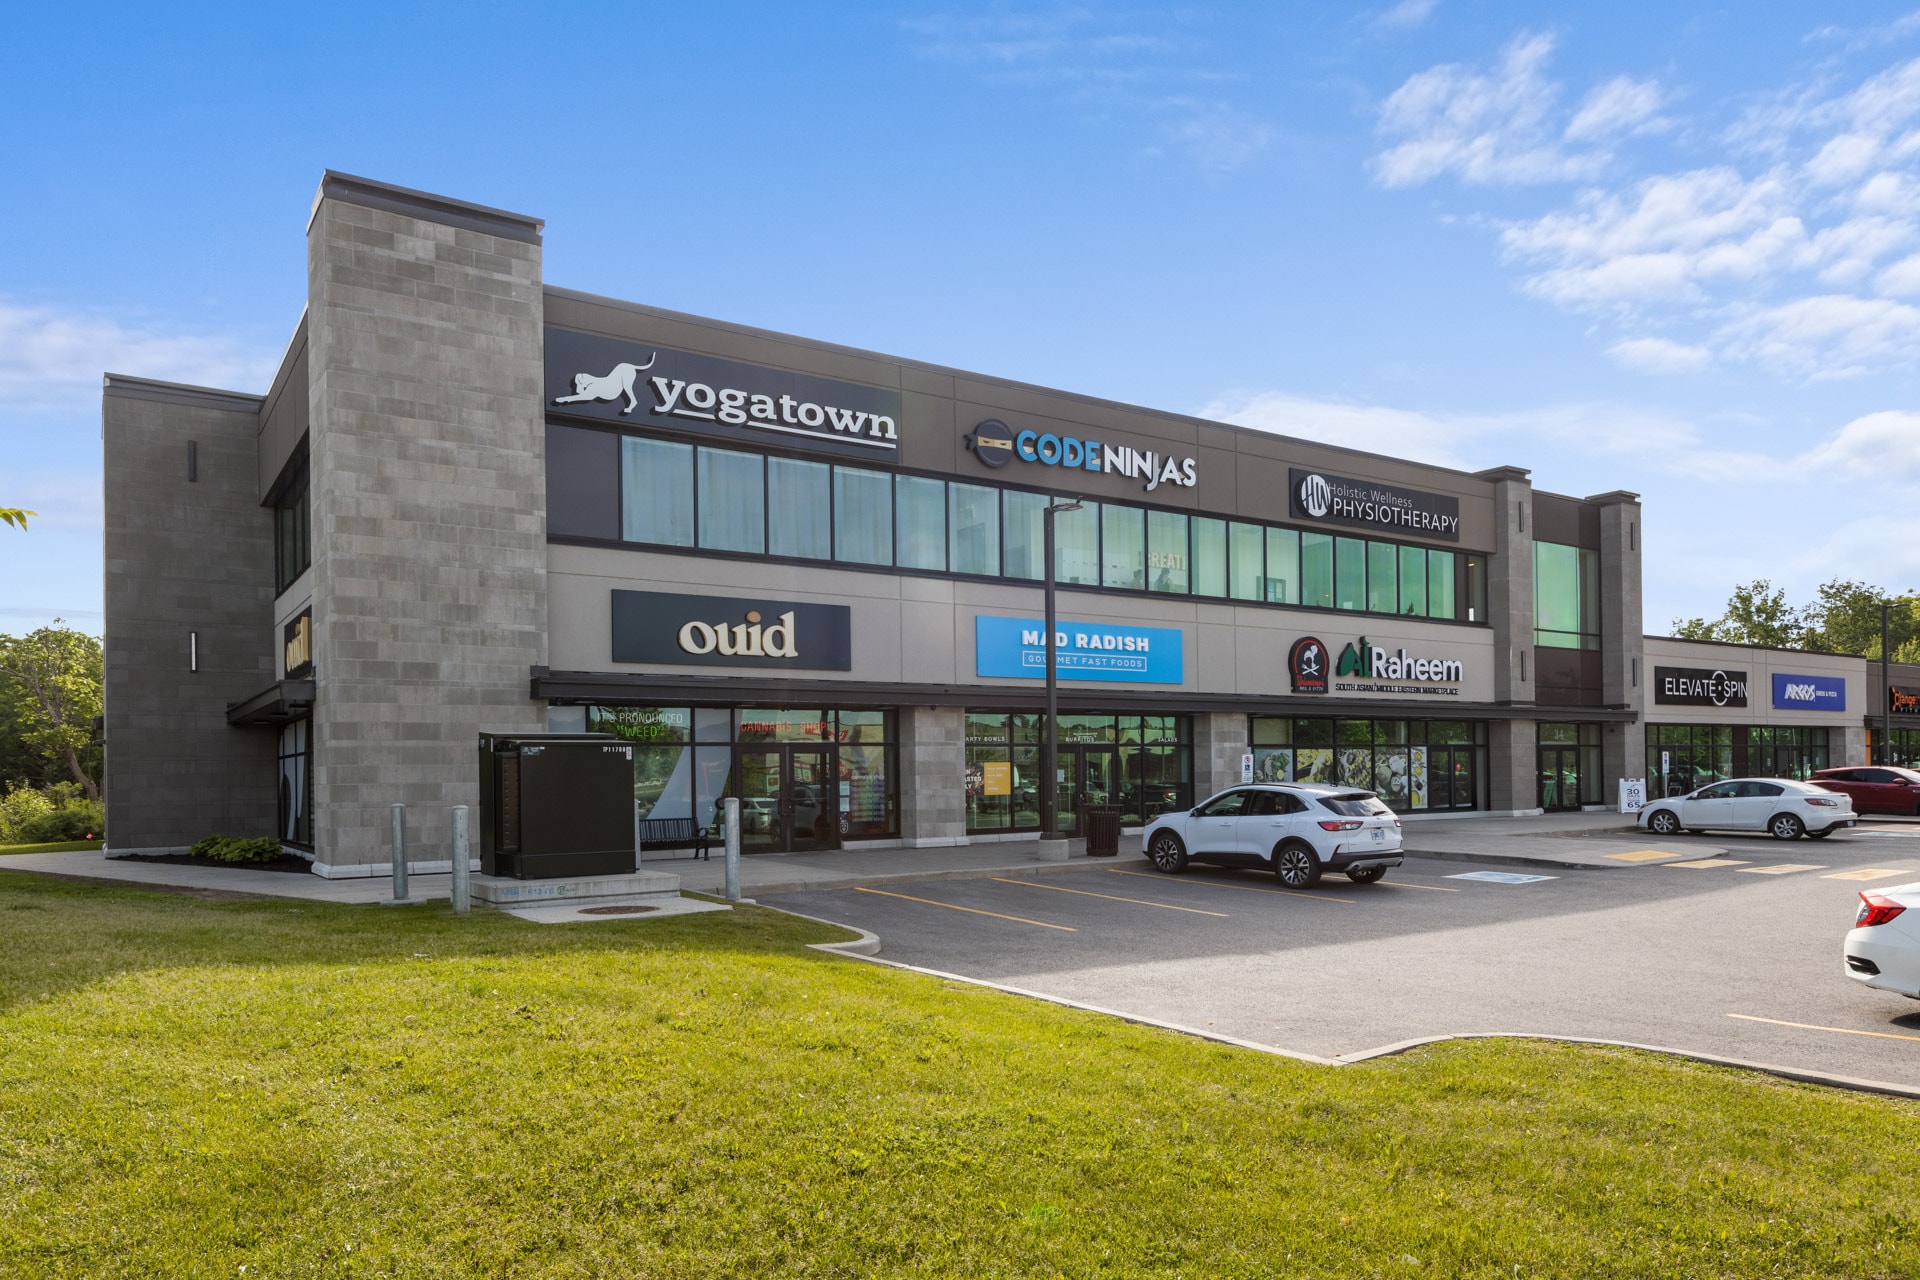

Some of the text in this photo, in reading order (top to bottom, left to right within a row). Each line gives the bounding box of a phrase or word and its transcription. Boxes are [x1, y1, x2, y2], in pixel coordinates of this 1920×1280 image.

[652, 376, 897, 440] yogatown
[1328, 482, 1413, 508] Holistic Wellness
[1333, 497, 1458, 533] PHYSIOTHERAPY
[679, 611, 798, 657] ouid
[1075, 633, 1149, 652] RADISH
[1028, 655, 1142, 668] GOUMET FAST FOODS
[1665, 677, 1748, 698] ELEVATE SPIN
[597, 712, 683, 724] IT'S PRONOUNCED
[740, 720, 827, 732] CANNABIS SHOP
